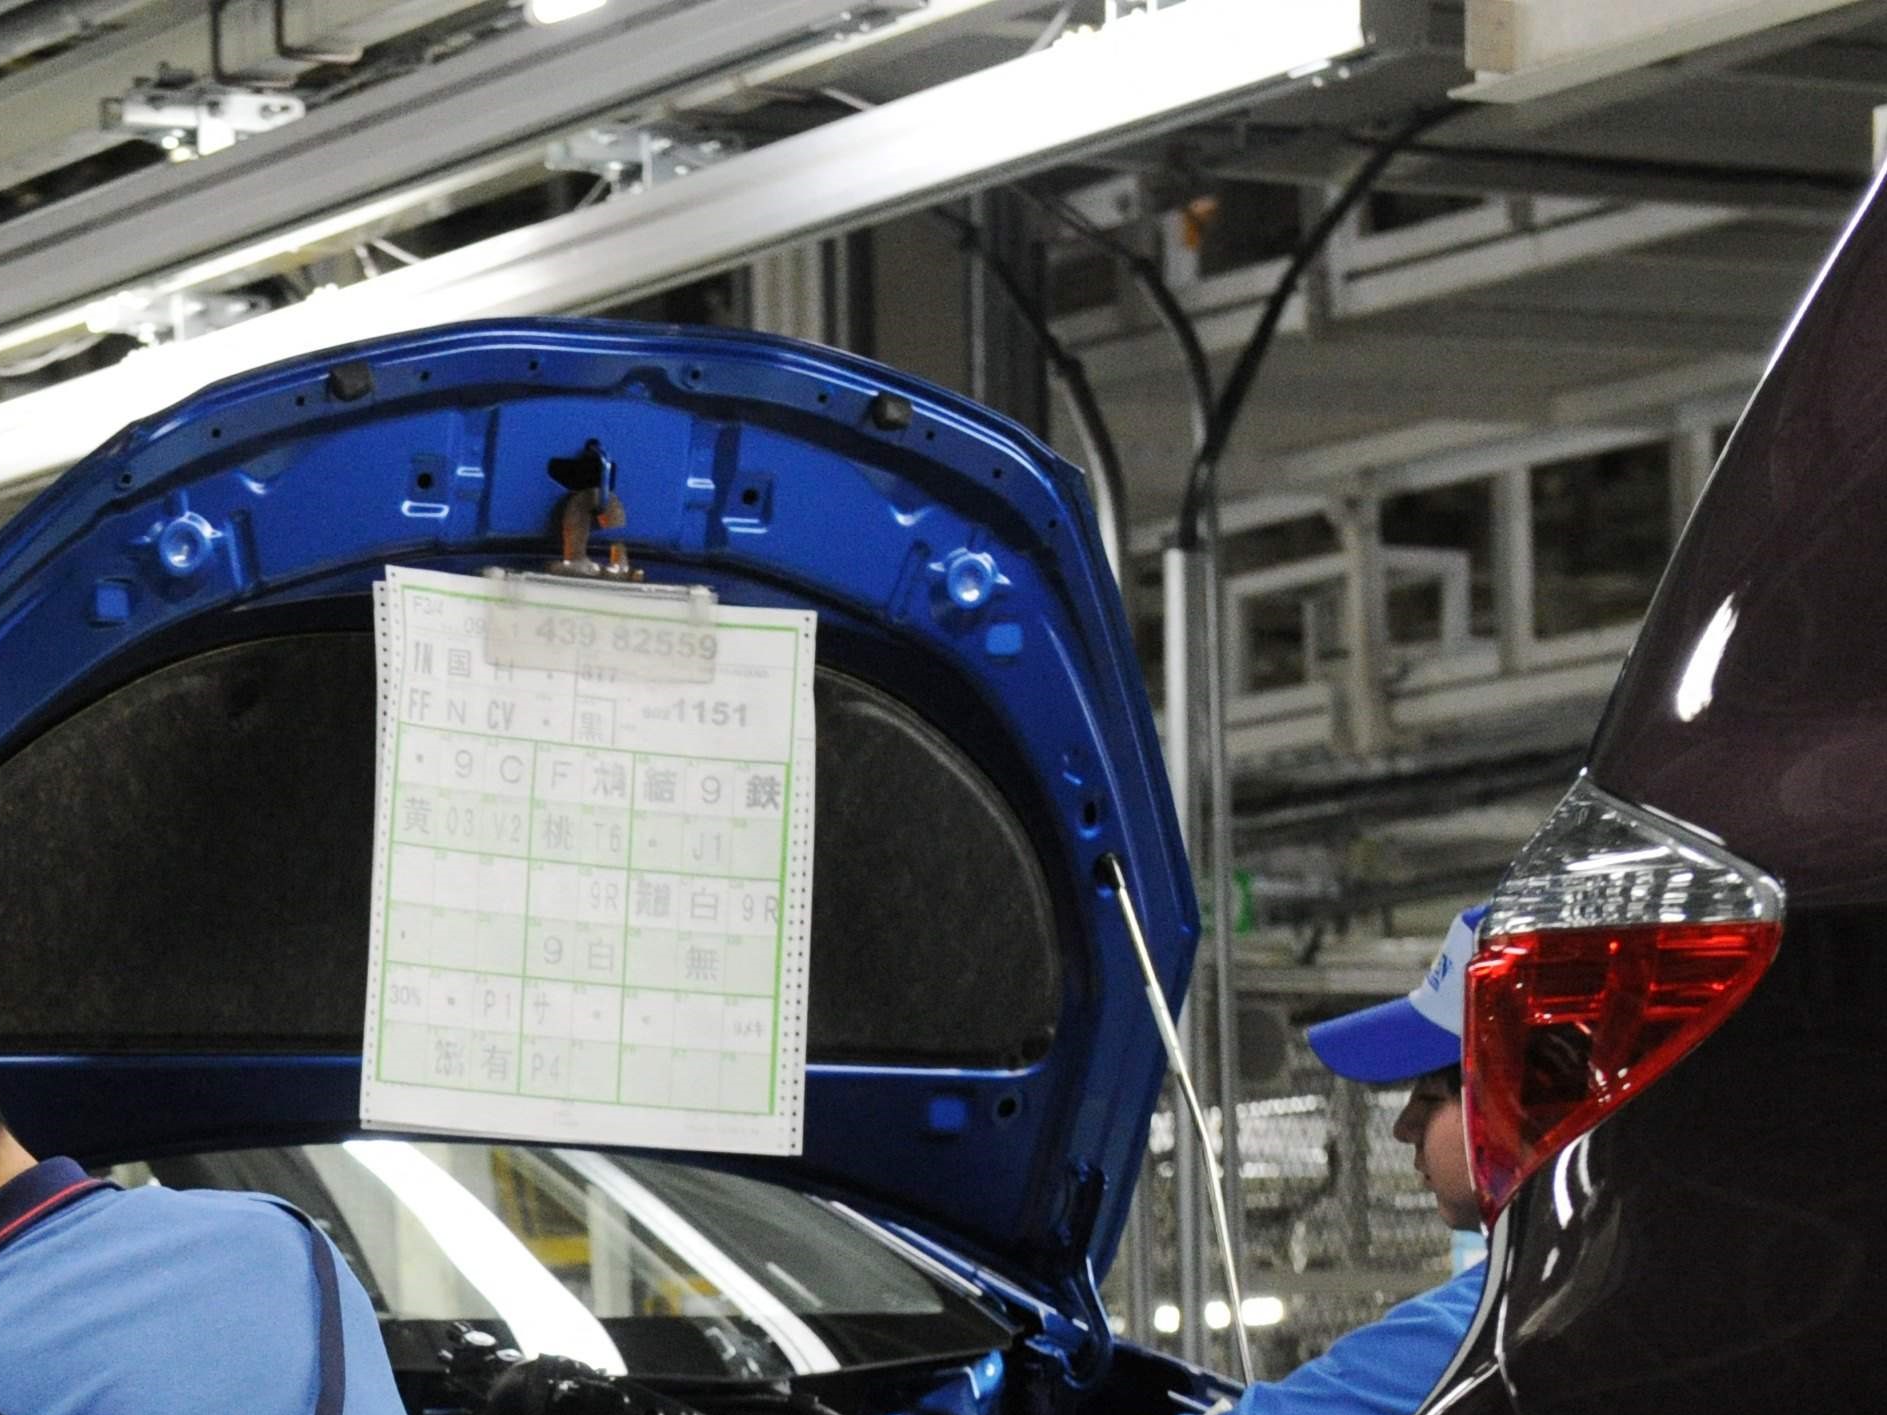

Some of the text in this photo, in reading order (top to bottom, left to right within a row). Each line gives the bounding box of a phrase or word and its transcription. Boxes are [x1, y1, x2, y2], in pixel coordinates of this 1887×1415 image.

[536, 615, 597, 647] 439
[612, 625, 717, 661] 82559
[448, 648, 471, 678] 国
[408, 687, 431, 722] FF
[447, 697, 466, 725] N
[488, 699, 516, 732] CV
[454, 749, 473, 779] 9
[500, 755, 524, 784] C
[550, 760, 573, 790] F
[700, 774, 722, 805] 9
[745, 774, 781, 811] 鉄
[402, 796, 433, 835] 黄
[543, 814, 575, 851] 桃
[690, 886, 720, 922] 白
[741, 893, 779, 926] 9R
[543, 935, 721, 982] 9 白 無
[481, 1044, 513, 1081] 有
